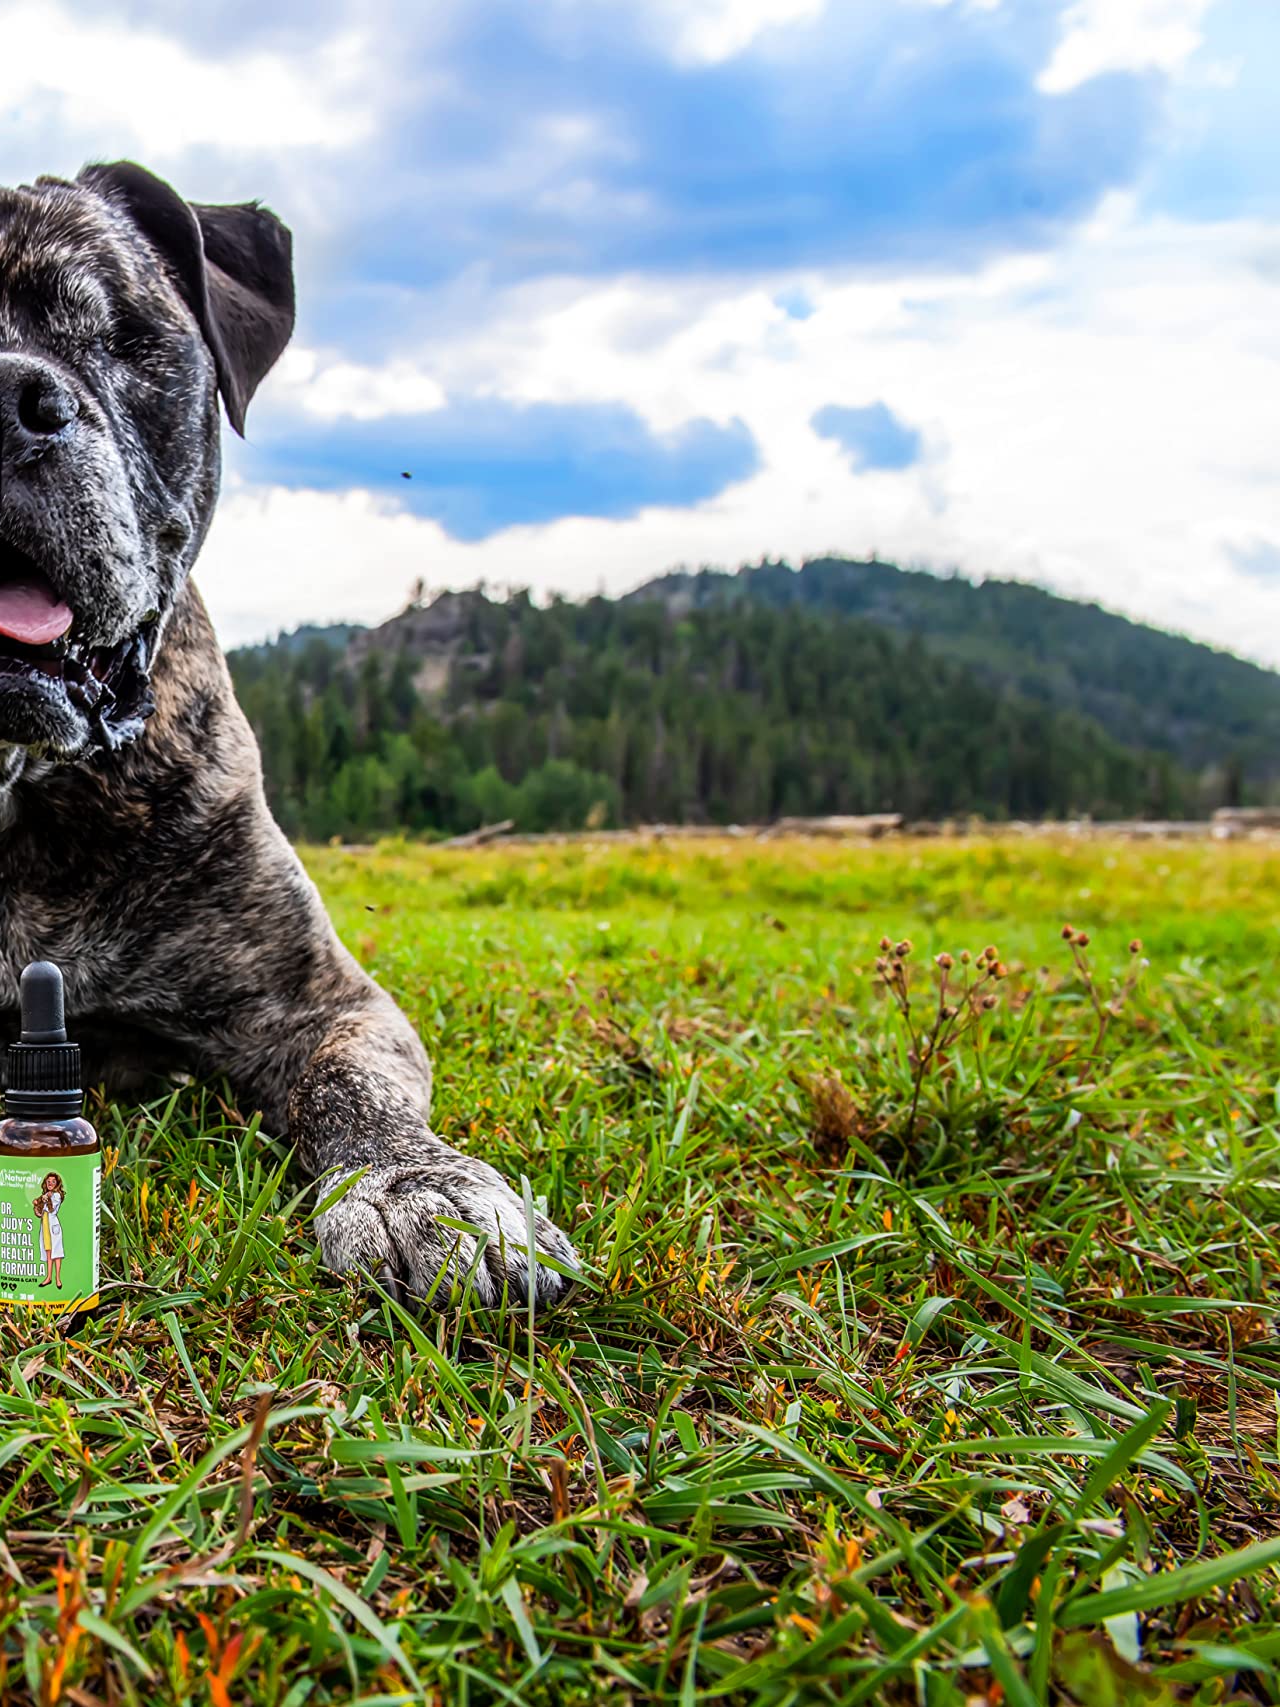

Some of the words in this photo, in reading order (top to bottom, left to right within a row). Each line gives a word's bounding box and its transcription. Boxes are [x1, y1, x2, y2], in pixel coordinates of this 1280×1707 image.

[5, 1173, 42, 1185] Naturally
[1, 1202, 14, 1215] DR.
[1, 1218, 33, 1231] JUDY'S
[1, 1232, 33, 1246] DENTAL
[1, 1247, 34, 1261] HEALTH
[1, 1262, 46, 1276] FORMULA
